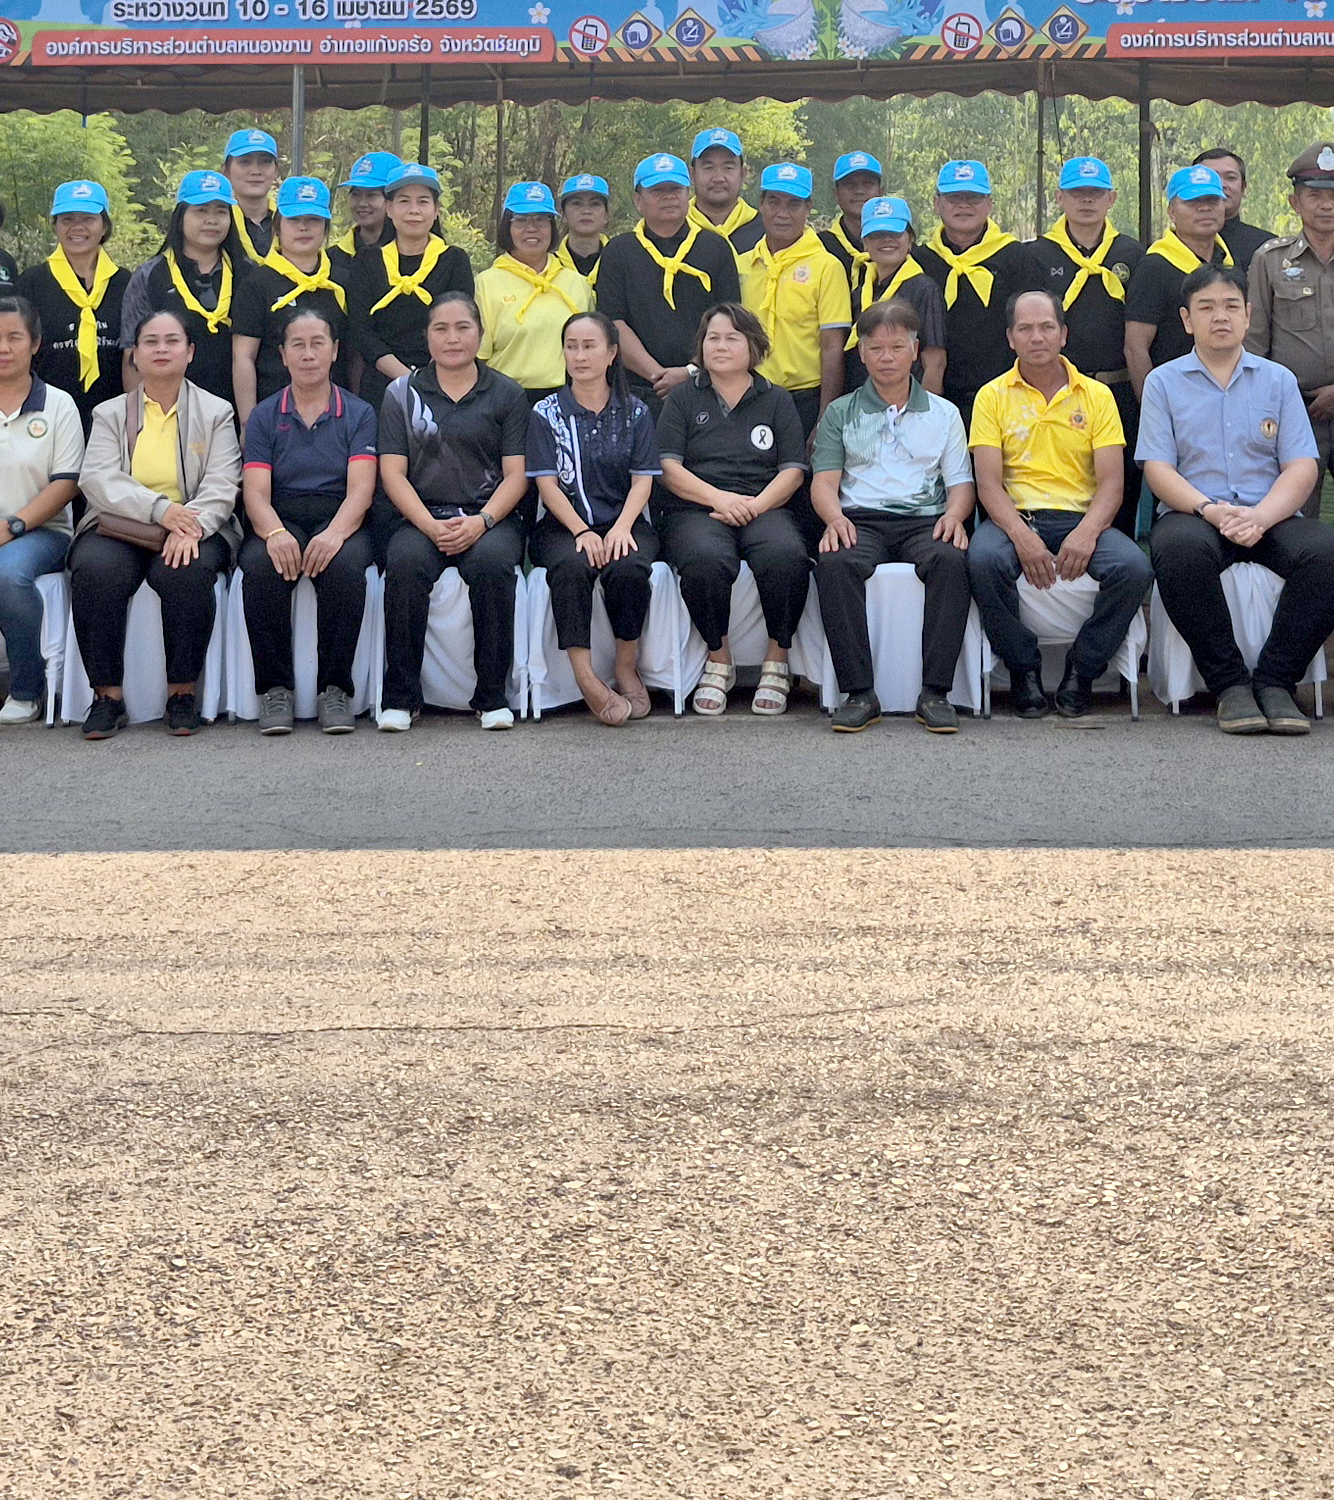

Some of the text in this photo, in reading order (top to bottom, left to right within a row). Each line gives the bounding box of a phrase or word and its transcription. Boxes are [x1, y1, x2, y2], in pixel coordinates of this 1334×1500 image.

[240, 0, 266, 16] 10
[299, 0, 325, 16] 16
[337, 0, 405, 17] เมษายน
[416, 0, 475, 16] 2569
[46, 35, 541, 56] องค์การบริหารส่วนตำบลหนองขาม อำเภอแก้งคร้อ จังหวัดชัยภูมิ
